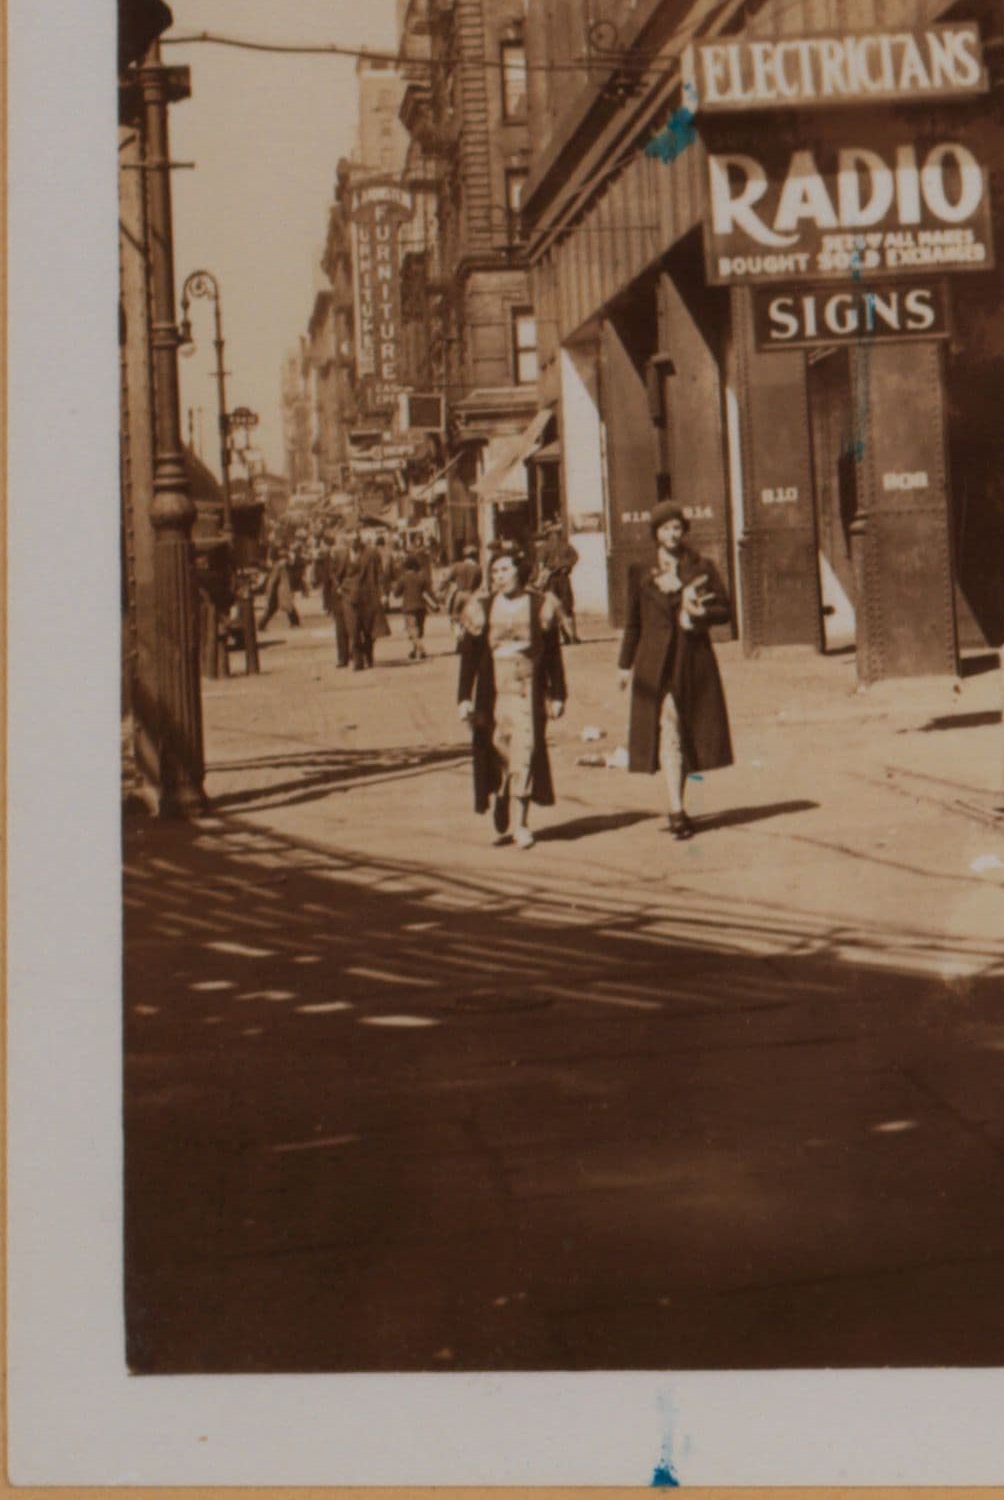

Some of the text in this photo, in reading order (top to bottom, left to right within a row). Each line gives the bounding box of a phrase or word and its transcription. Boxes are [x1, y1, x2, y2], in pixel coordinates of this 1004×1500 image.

[702, 30, 980, 101] ELECTRICIANS
[708, 142, 984, 247] RADIO
[374, 205, 397, 380] FURNITURE
[718, 252, 810, 277] BOUGHT
[767, 289, 936, 340] SIGNS
